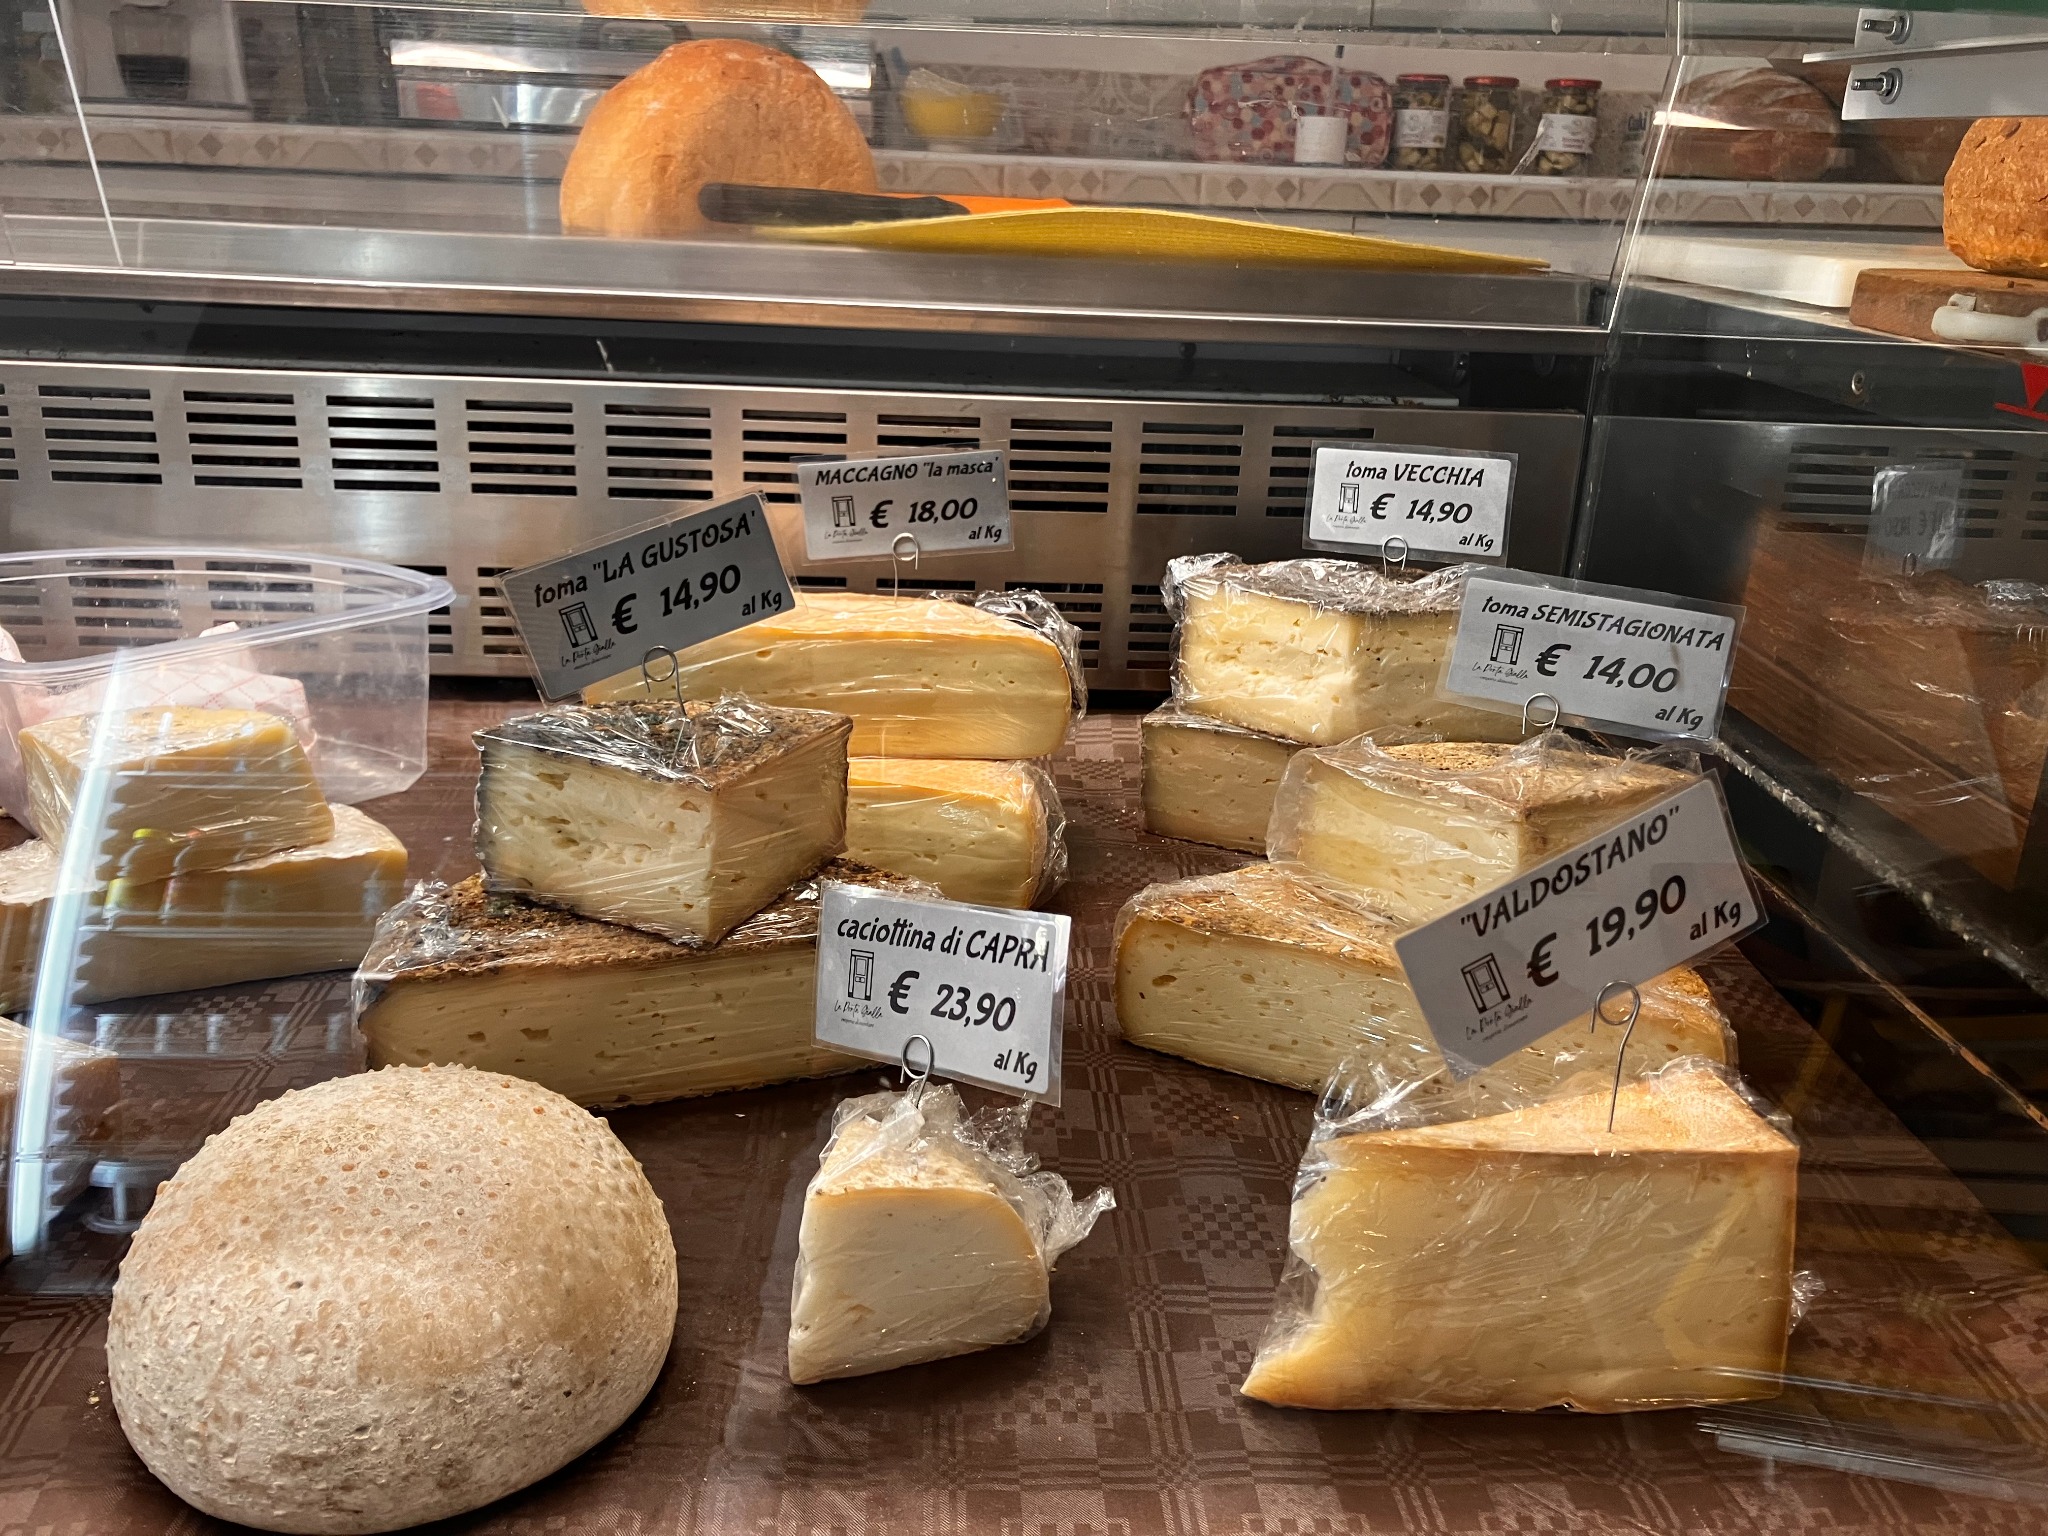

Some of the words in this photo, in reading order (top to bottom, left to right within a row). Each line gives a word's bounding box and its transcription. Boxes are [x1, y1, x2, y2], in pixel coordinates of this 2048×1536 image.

[815, 463, 918, 486] MACCAGNO
[1345, 460, 1388, 480] toma
[1394, 463, 1485, 488] VECCHIA
[869, 500, 893, 528] €
[908, 497, 978, 524] 18,00
[1370, 493, 1396, 519] €
[1405, 499, 1473, 524] 14,90
[968, 527, 981, 540] al
[984, 524, 1002, 542] Kg
[1458, 533, 1473, 546] al
[1475, 533, 1494, 552] Kg
[534, 575, 588, 608] toma
[592, 551, 635, 584] "LA
[611, 592, 639, 635] €
[659, 564, 741, 617] 14,90
[741, 595, 756, 617] al
[760, 589, 782, 611] Kg
[1481, 595, 1528, 618] toma
[1531, 604, 1726, 651] SEMISTAGIONATA
[1535, 643, 1572, 677] €
[1582, 655, 1679, 692] 14,00
[1655, 705, 1675, 722] al
[1676, 707, 1704, 731] Kg
[1460, 805, 1680, 937] "VALDOSTANO"
[837, 917, 936, 951] caciottina
[940, 926, 963, 956] di
[1526, 932, 1560, 988] €
[1585, 874, 1686, 957] 19,90
[1689, 919, 1708, 941] al
[1714, 900, 1742, 929] Kg
[888, 970, 920, 1015] €
[930, 983, 1016, 1032] 23,90
[993, 1049, 1012, 1071] al
[1013, 1051, 1038, 1084] Kg
